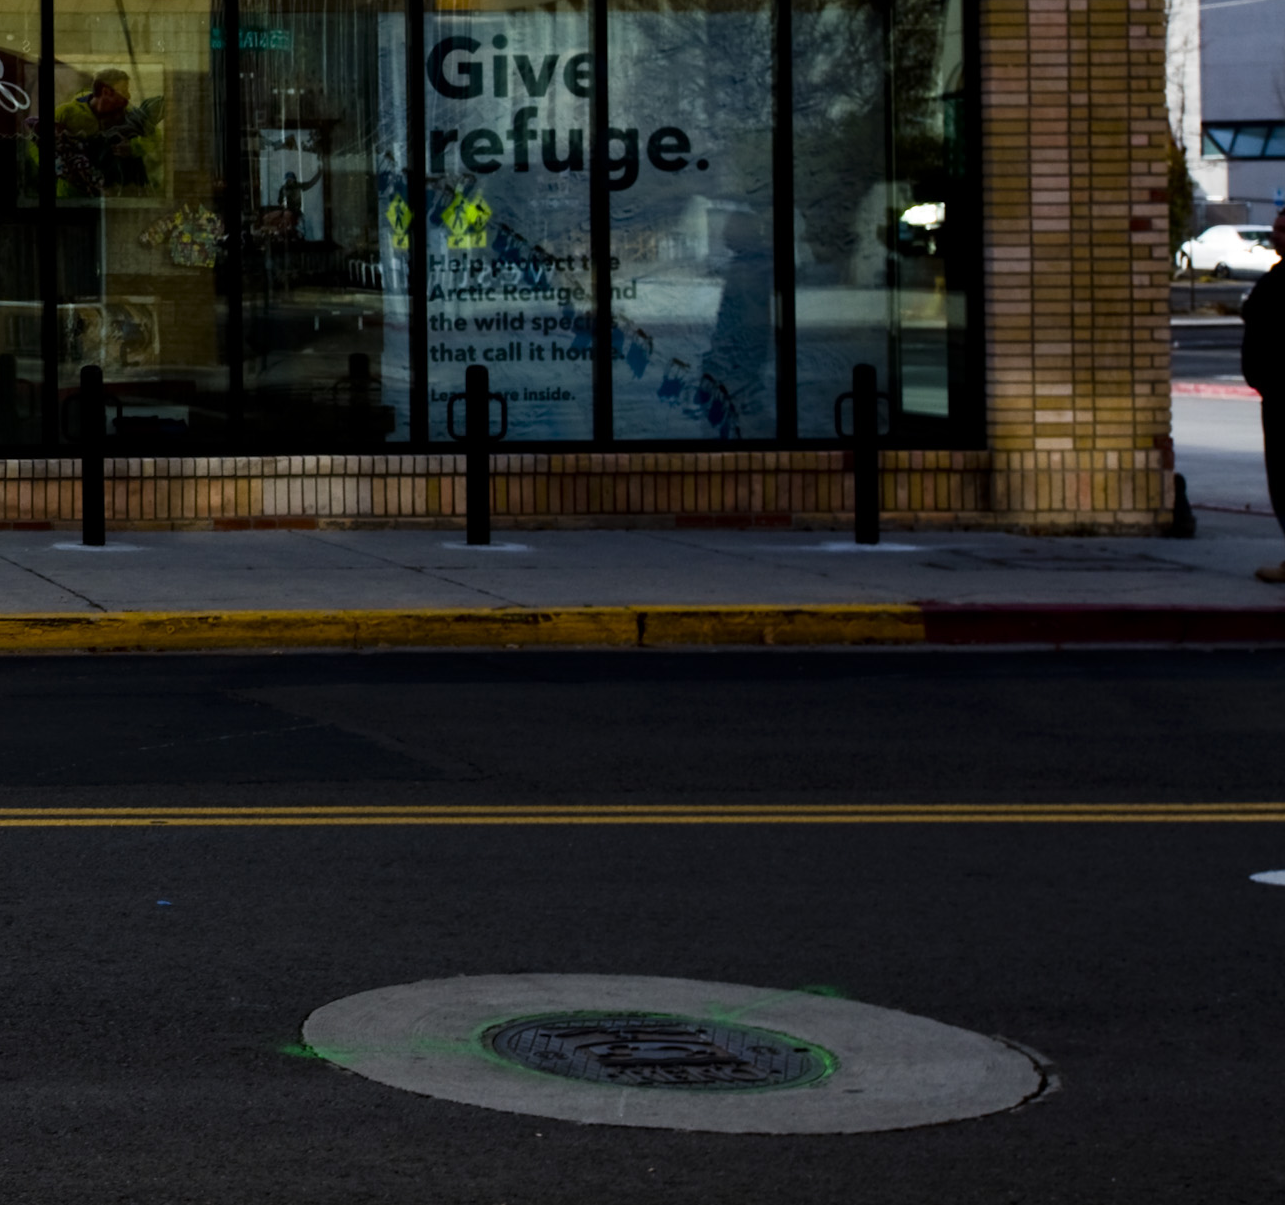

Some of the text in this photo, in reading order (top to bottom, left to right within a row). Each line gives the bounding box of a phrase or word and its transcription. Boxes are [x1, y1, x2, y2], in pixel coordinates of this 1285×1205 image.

[427, 34, 601, 99] Give
[430, 106, 709, 191] refuge.
[429, 253, 483, 277] Help
[491, 255, 575, 278] protect
[581, 256, 620, 272] te
[429, 283, 496, 302] Arctic
[503, 284, 586, 306] Refuge
[429, 311, 617, 336] the wild specis
[429, 343, 476, 362] that
[483, 342, 521, 361] call
[530, 342, 544, 361] it
[524, 387, 576, 401] inside.
